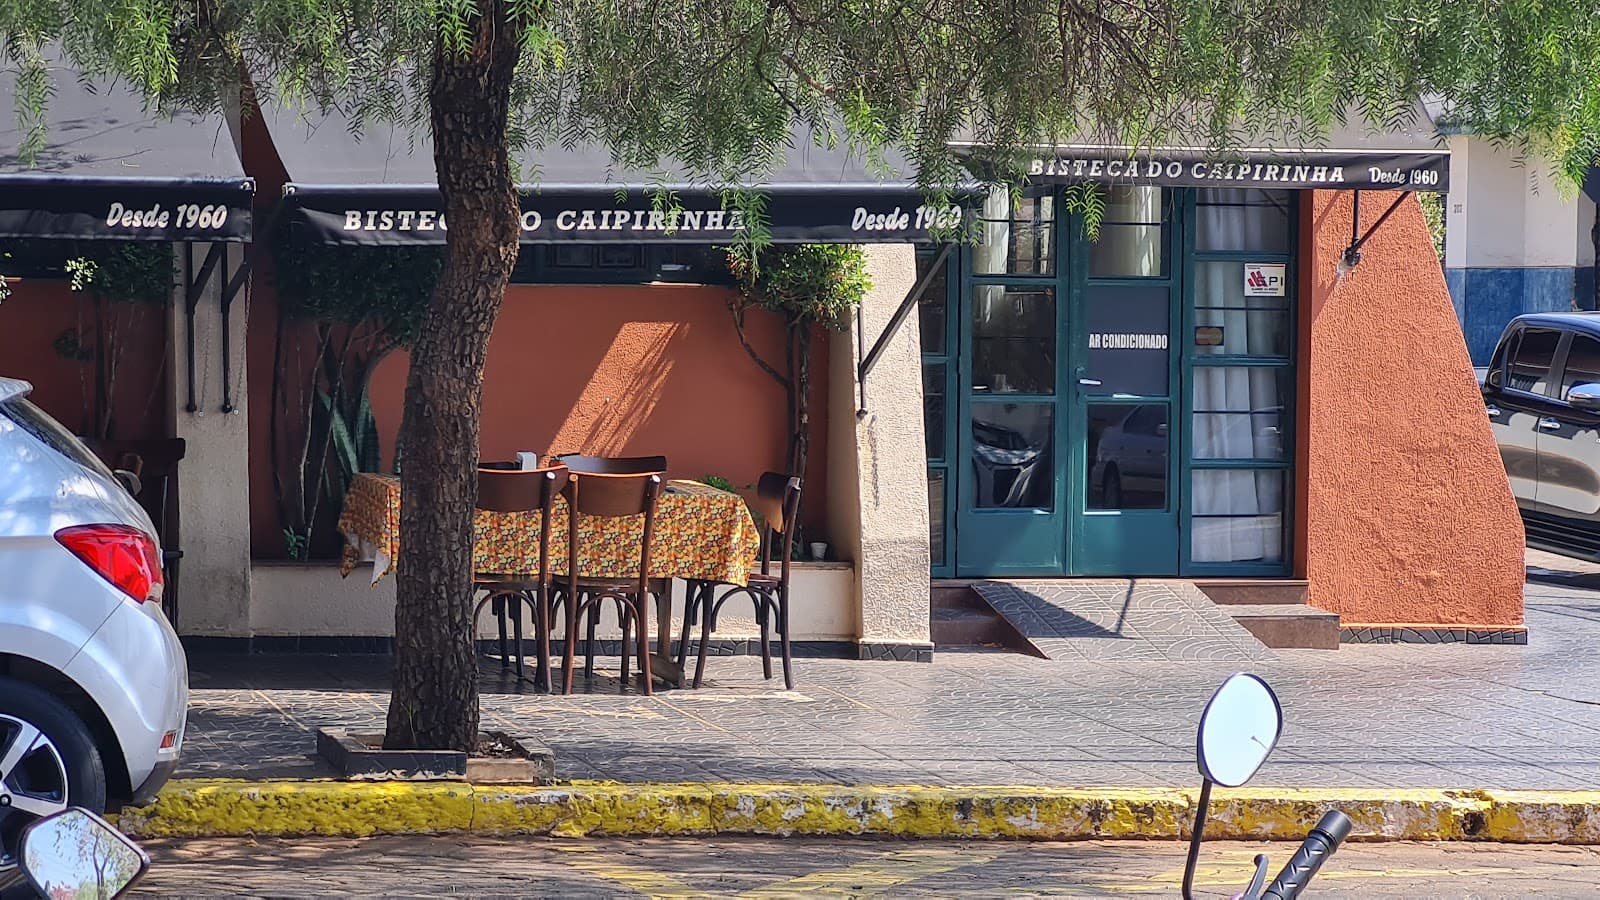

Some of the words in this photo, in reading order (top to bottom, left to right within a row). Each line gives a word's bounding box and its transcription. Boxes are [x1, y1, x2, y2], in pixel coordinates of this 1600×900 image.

[1028, 159, 1139, 178] BISTECA
[1145, 161, 1183, 179] DO
[1191, 162, 1345, 183] CAIPIRINHA
[1368, 167, 1406, 184] Desde
[1409, 168, 1438, 186] 1960
[106, 202, 169, 229] Desde
[175, 204, 228, 230] 1960
[343, 210, 448, 232] BISTE
[519, 210, 542, 232] O
[556, 210, 746, 231] CAIPIRINHA
[851, 206, 909, 231] Desde
[915, 205, 963, 230] 1960
[1088, 333, 1101, 349] AR
[1102, 333, 1168, 350] CONDICIONADO
